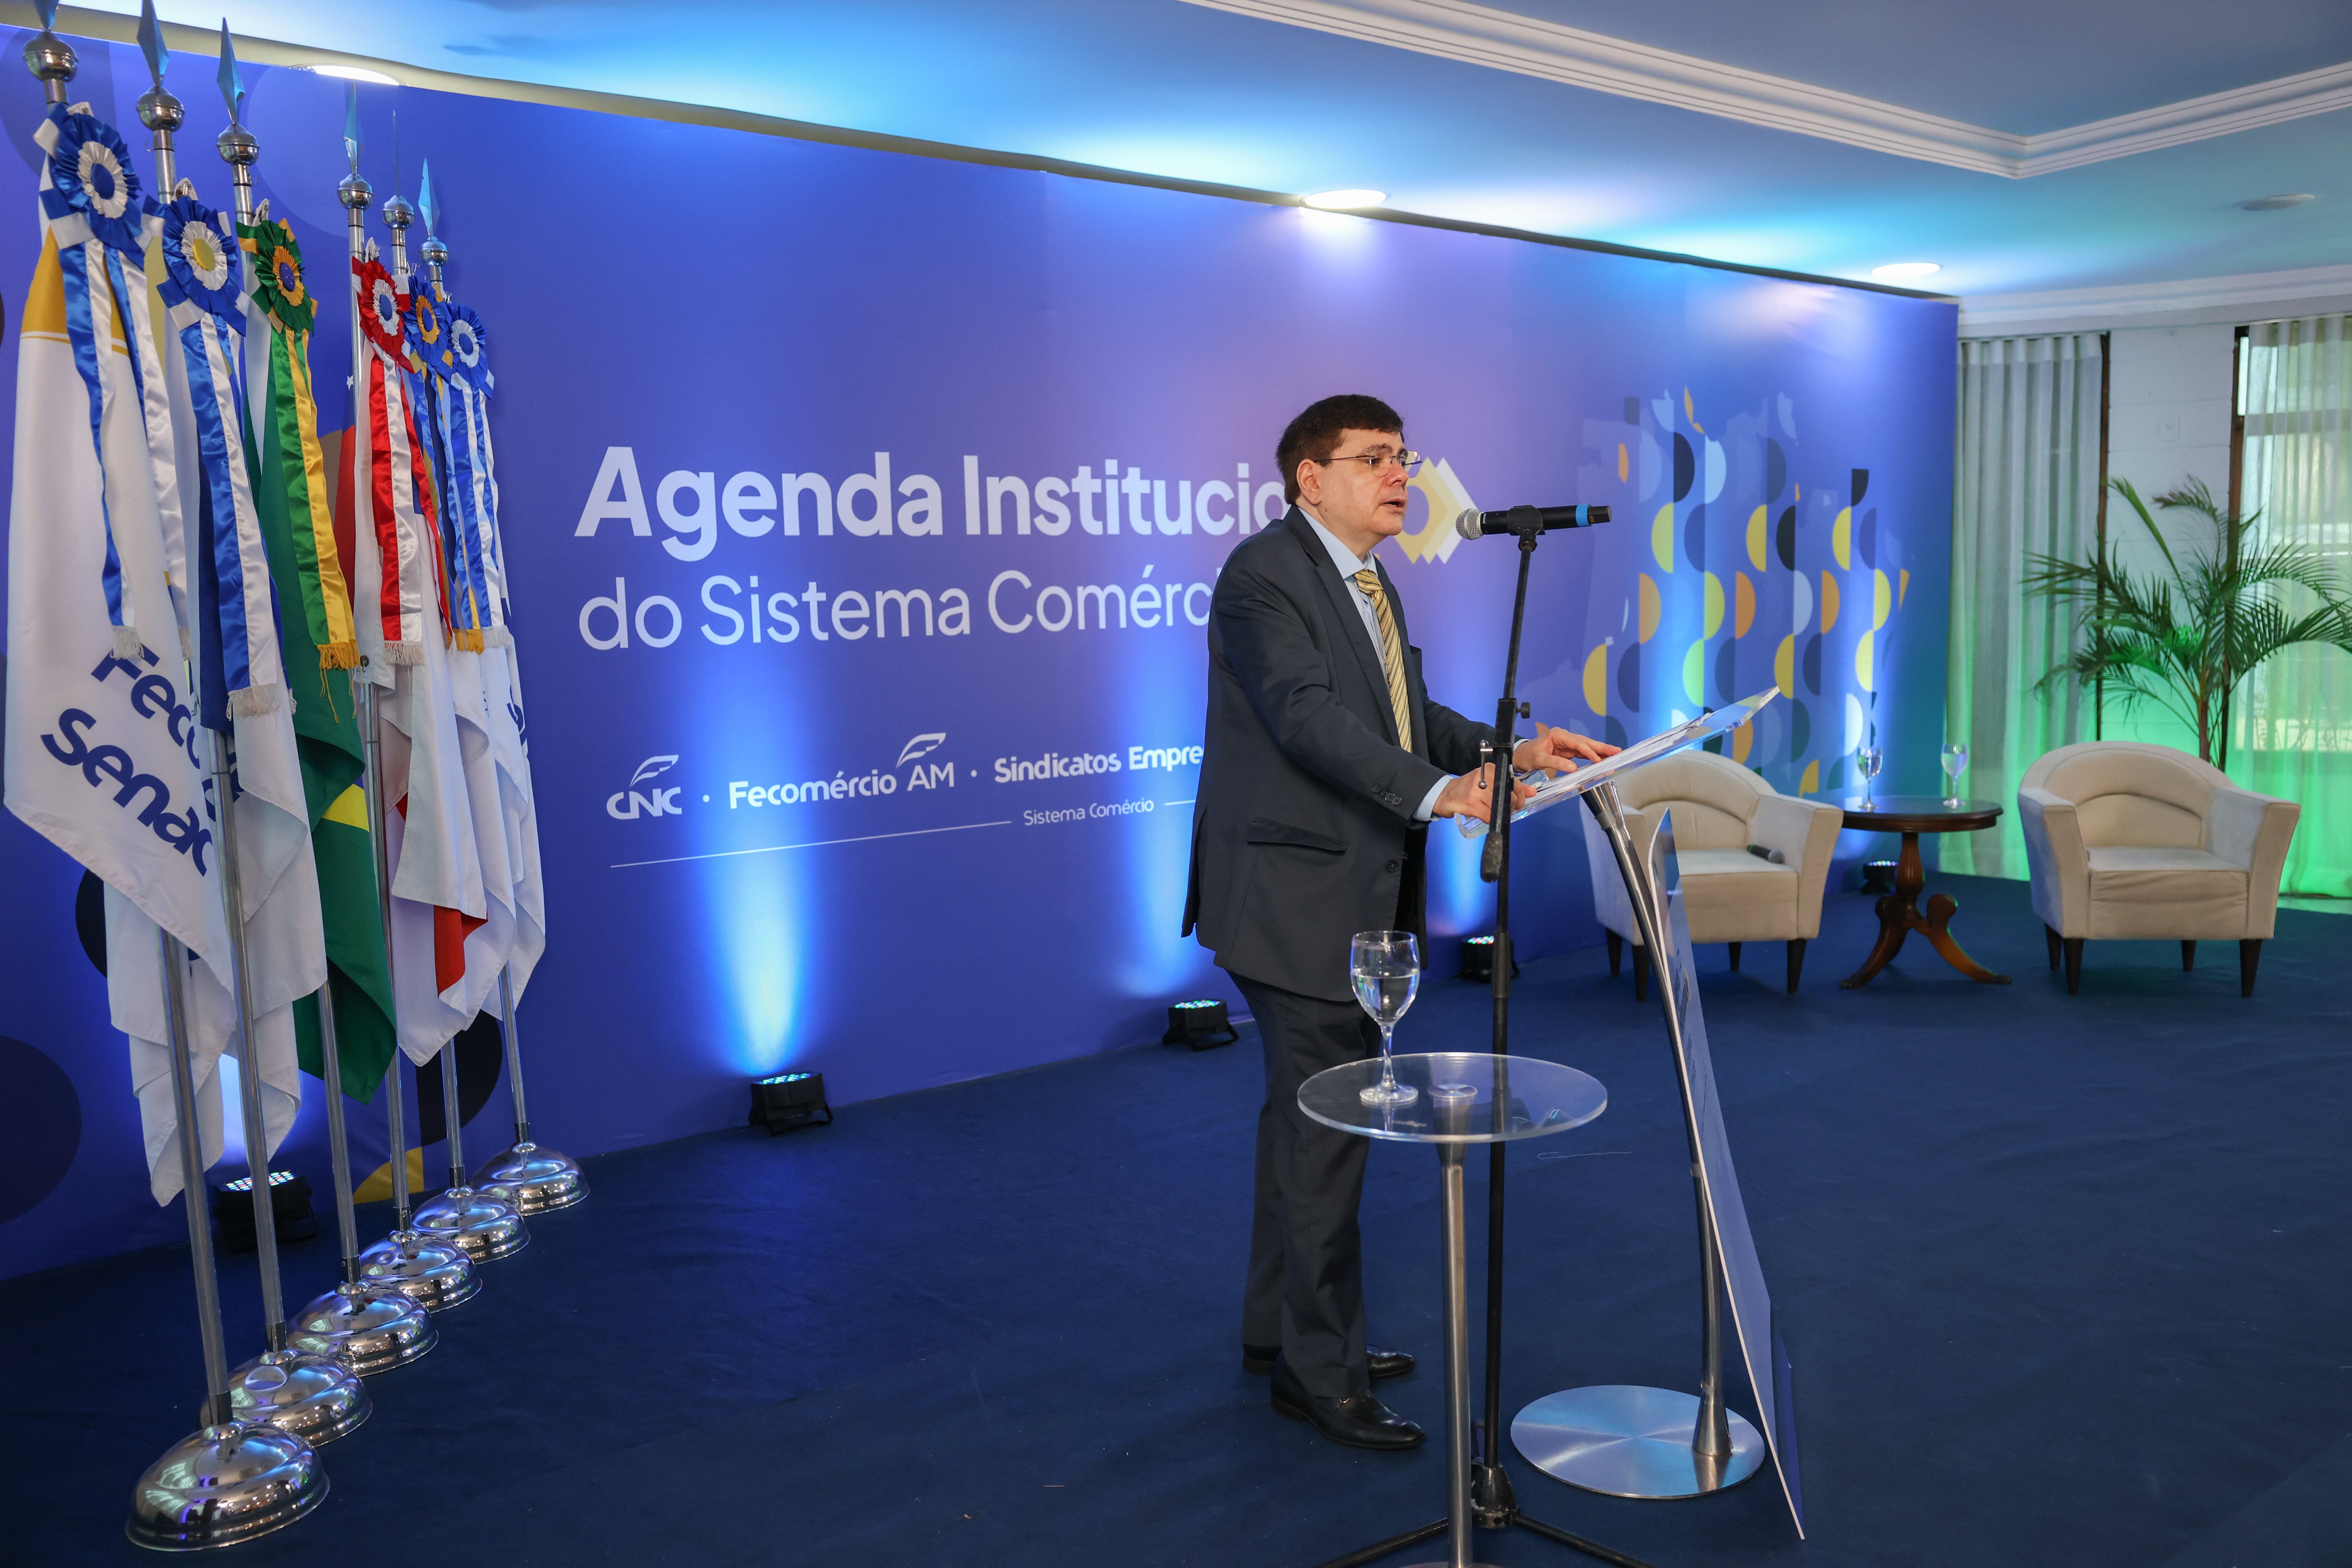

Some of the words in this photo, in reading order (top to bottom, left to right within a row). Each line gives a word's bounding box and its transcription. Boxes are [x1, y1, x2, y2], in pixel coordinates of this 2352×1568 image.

[574, 446, 943, 562] Agenda
[964, 455, 1291, 536] Institucio
[579, 577, 682, 650] do
[701, 575, 971, 645] Sistema
[988, 564, 1221, 634] Comérc
[729, 769, 897, 809] Fecomércio
[907, 762, 955, 791] AM
[995, 753, 1122, 783] Sindicatos
[1129, 746, 1203, 771] Empre
[40, 708, 212, 877] Senac
[606, 787, 682, 820] CNC
[1024, 808, 1085, 826] Sistema
[1090, 799, 1154, 817] Comércio
